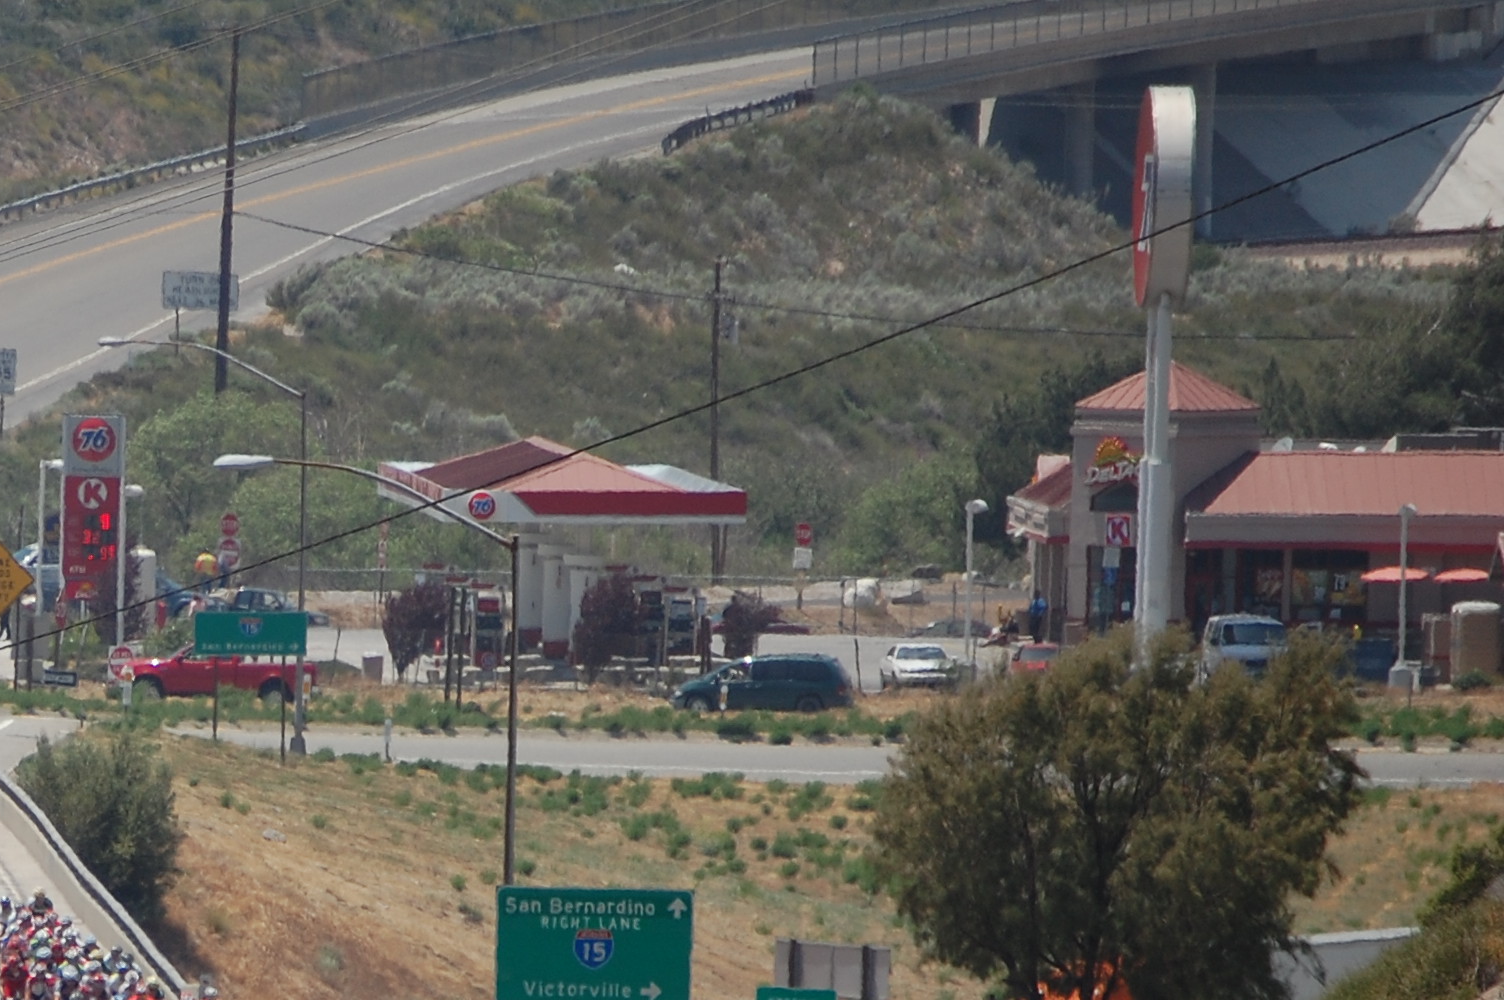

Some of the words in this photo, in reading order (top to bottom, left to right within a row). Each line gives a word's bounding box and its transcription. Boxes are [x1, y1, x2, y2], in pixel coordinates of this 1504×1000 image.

[77, 426, 109, 452] 76
[472, 496, 492, 515] 76
[1109, 518, 1130, 545] K
[246, 623, 258, 634] 15
[505, 896, 542, 915] San
[550, 897, 656, 916] Bernardino
[540, 915, 591, 930] RIGHT
[599, 916, 641, 931] LANE
[583, 941, 606, 962] 15
[523, 980, 632, 999] Victorville
